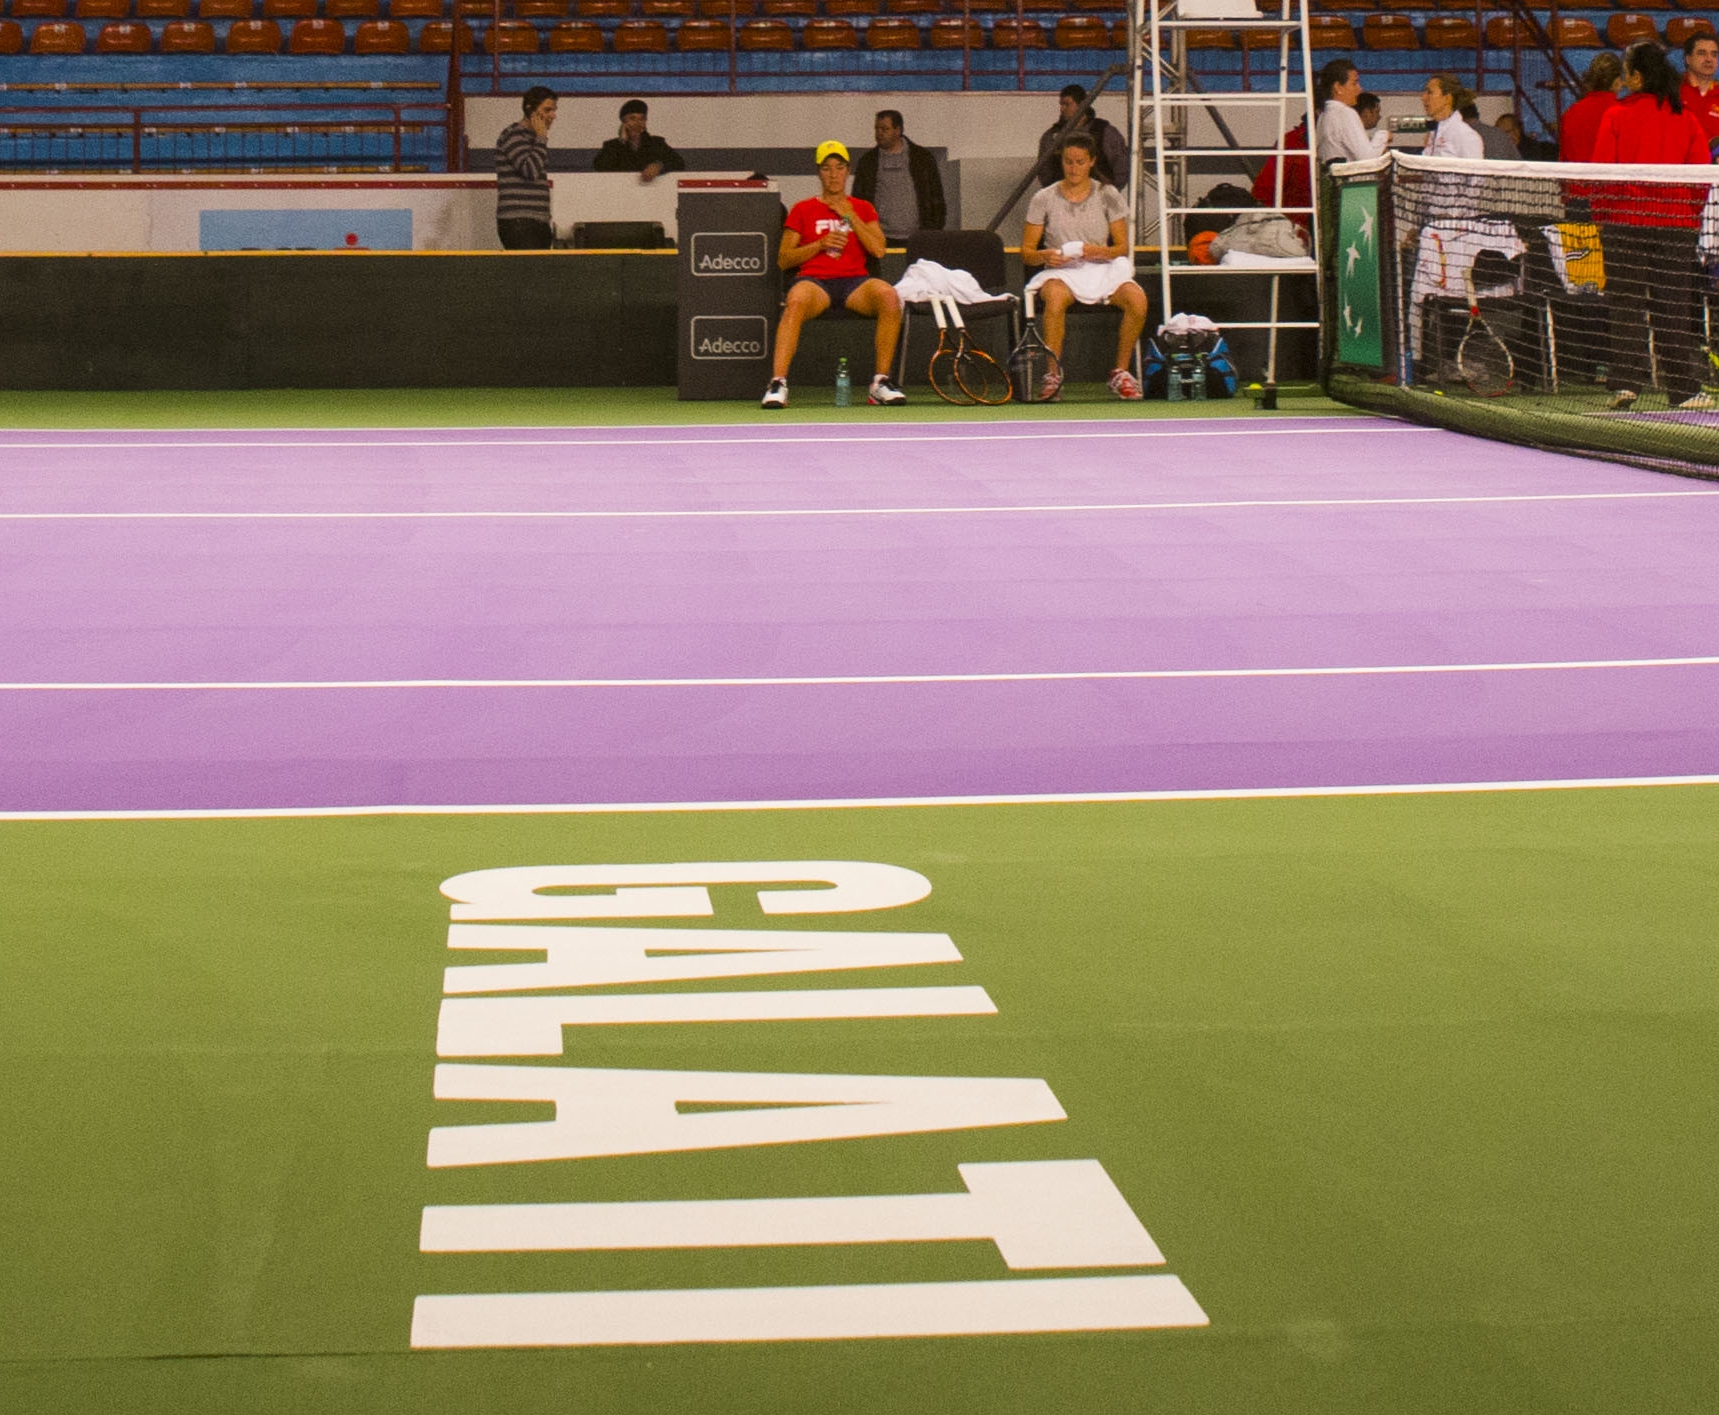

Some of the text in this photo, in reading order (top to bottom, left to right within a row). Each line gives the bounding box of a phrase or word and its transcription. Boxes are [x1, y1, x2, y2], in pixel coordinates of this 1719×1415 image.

[815, 218, 853, 235] FI
[698, 253, 761, 270] Adecco
[698, 337, 761, 353] Adecco
[410, 860, 1210, 1349] GALATI
